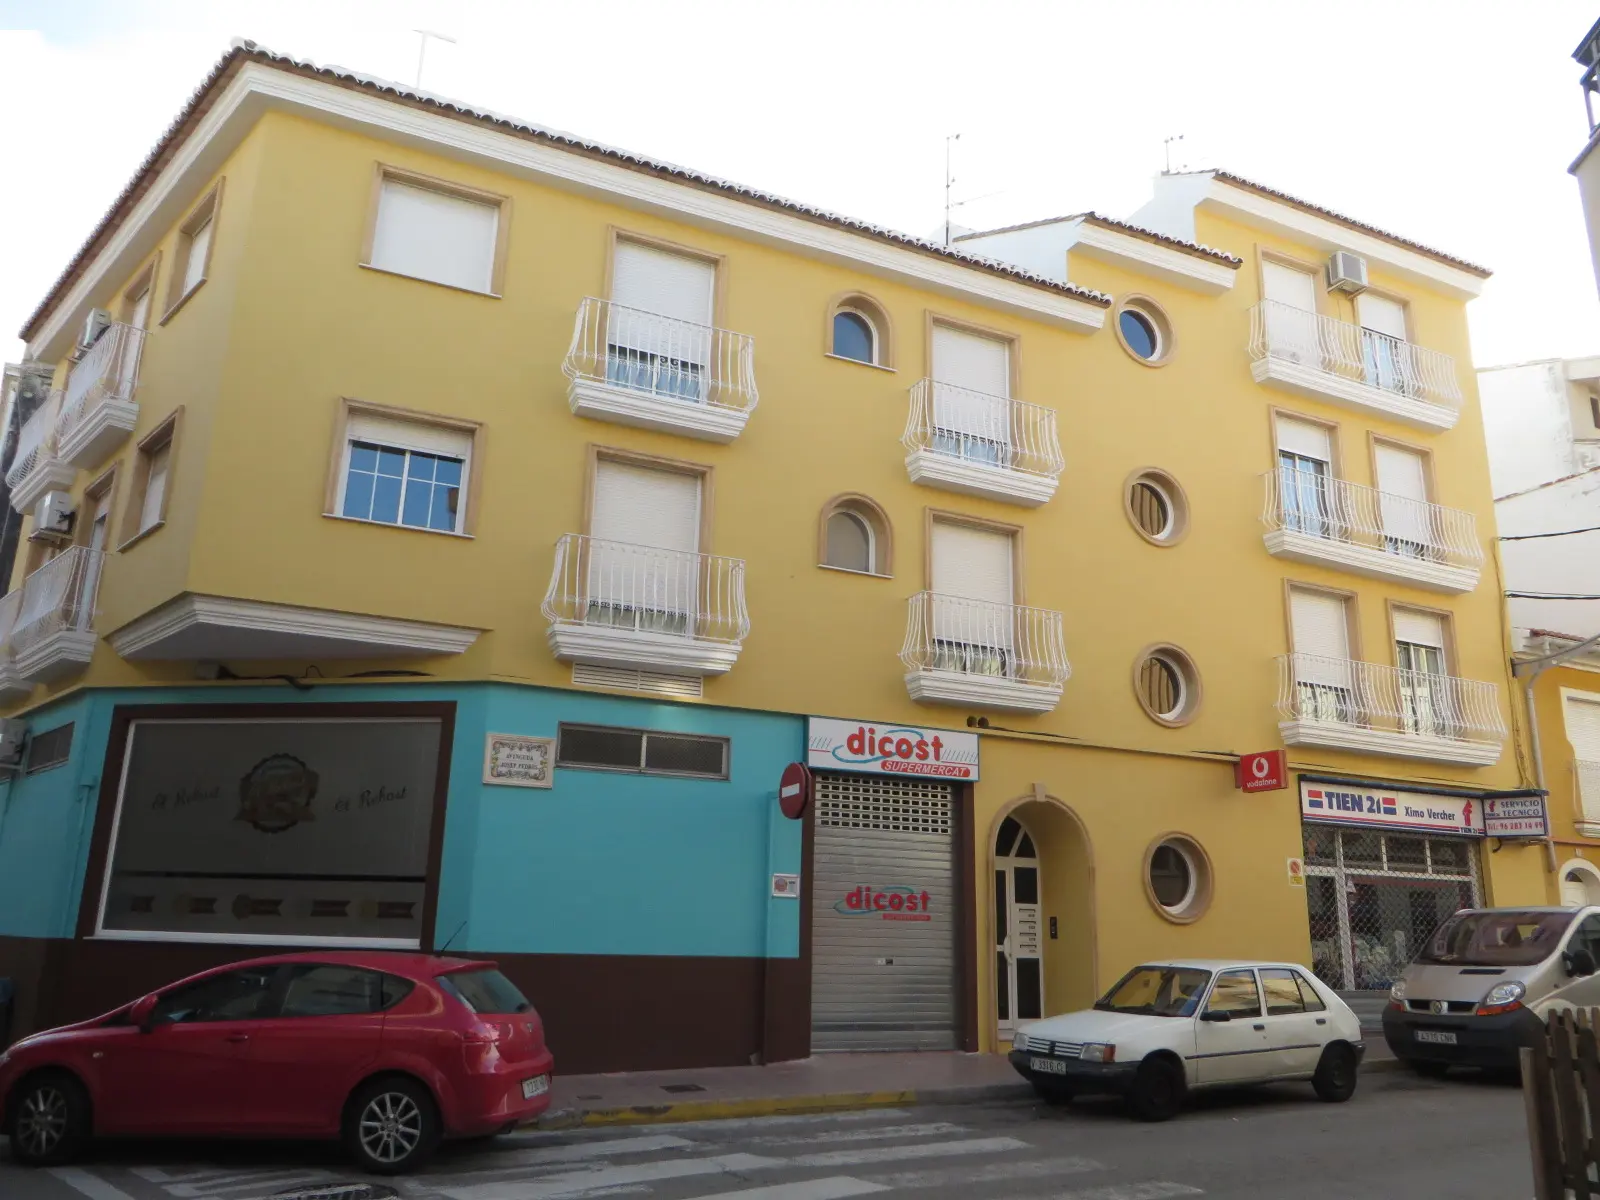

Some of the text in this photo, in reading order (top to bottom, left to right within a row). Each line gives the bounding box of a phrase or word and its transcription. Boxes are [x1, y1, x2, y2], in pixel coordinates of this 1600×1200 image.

[847, 727, 943, 761] dicost
[884, 761, 966, 776] SUPERMERCAT
[1246, 778, 1277, 788] vodafone
[1325, 791, 1381, 814] TIEN 21
[1500, 799, 1540, 808] SERVICIO
[1404, 806, 1456, 821] Ximo Vercher
[1503, 808, 1540, 817] TECNICO
[845, 886, 930, 911] dicost
